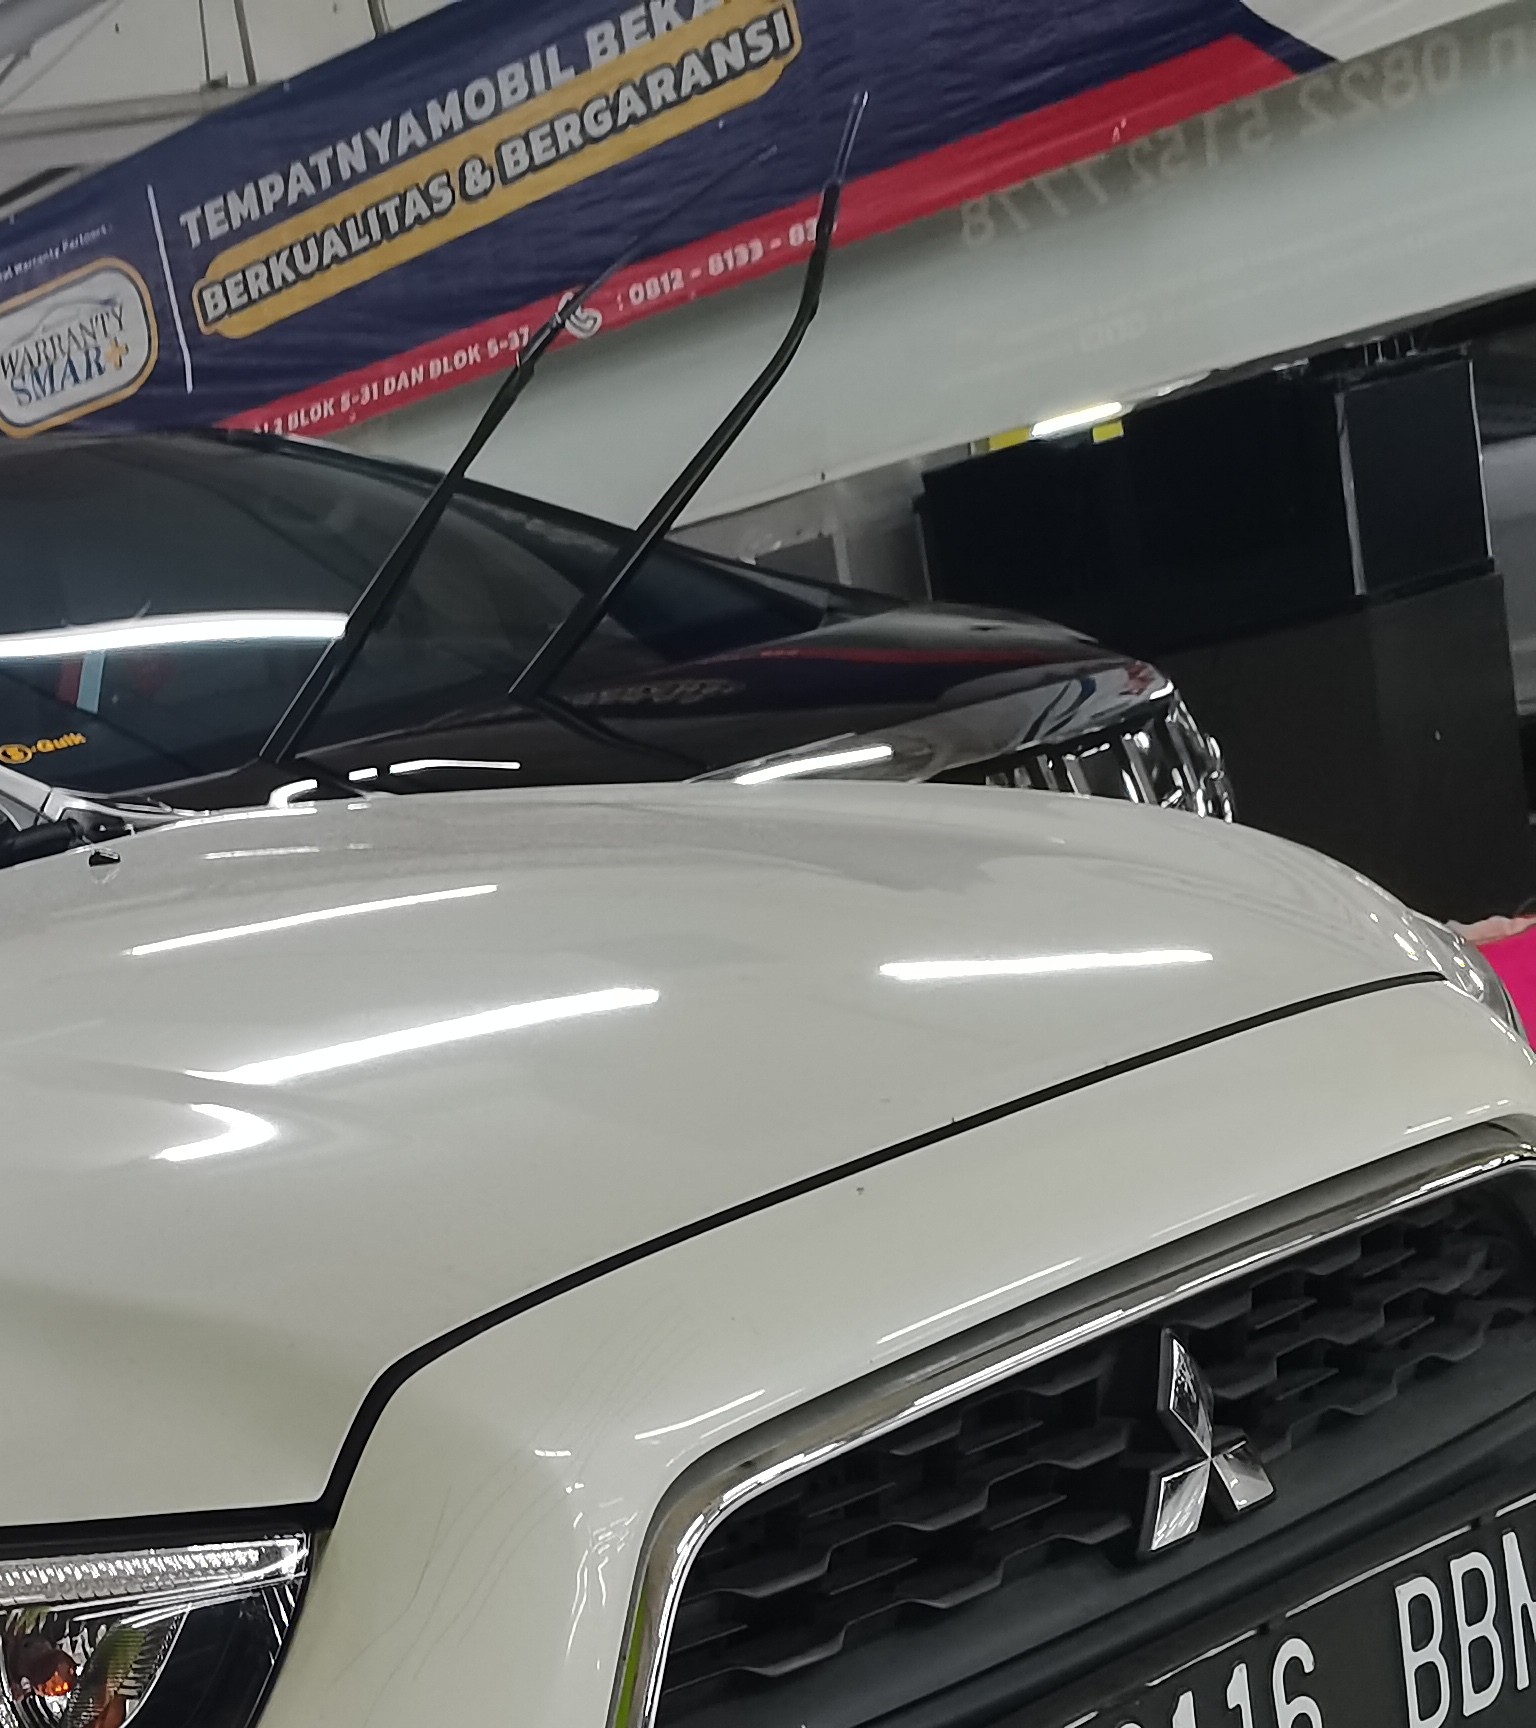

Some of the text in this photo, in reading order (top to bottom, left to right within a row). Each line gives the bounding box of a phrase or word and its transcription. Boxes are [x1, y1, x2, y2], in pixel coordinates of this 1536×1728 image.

[201, 8, 792, 323] BERKUALITAS & BERGARANSI
[0, 303, 125, 380] WARRANTY
[383, 364, 424, 396] DAN
